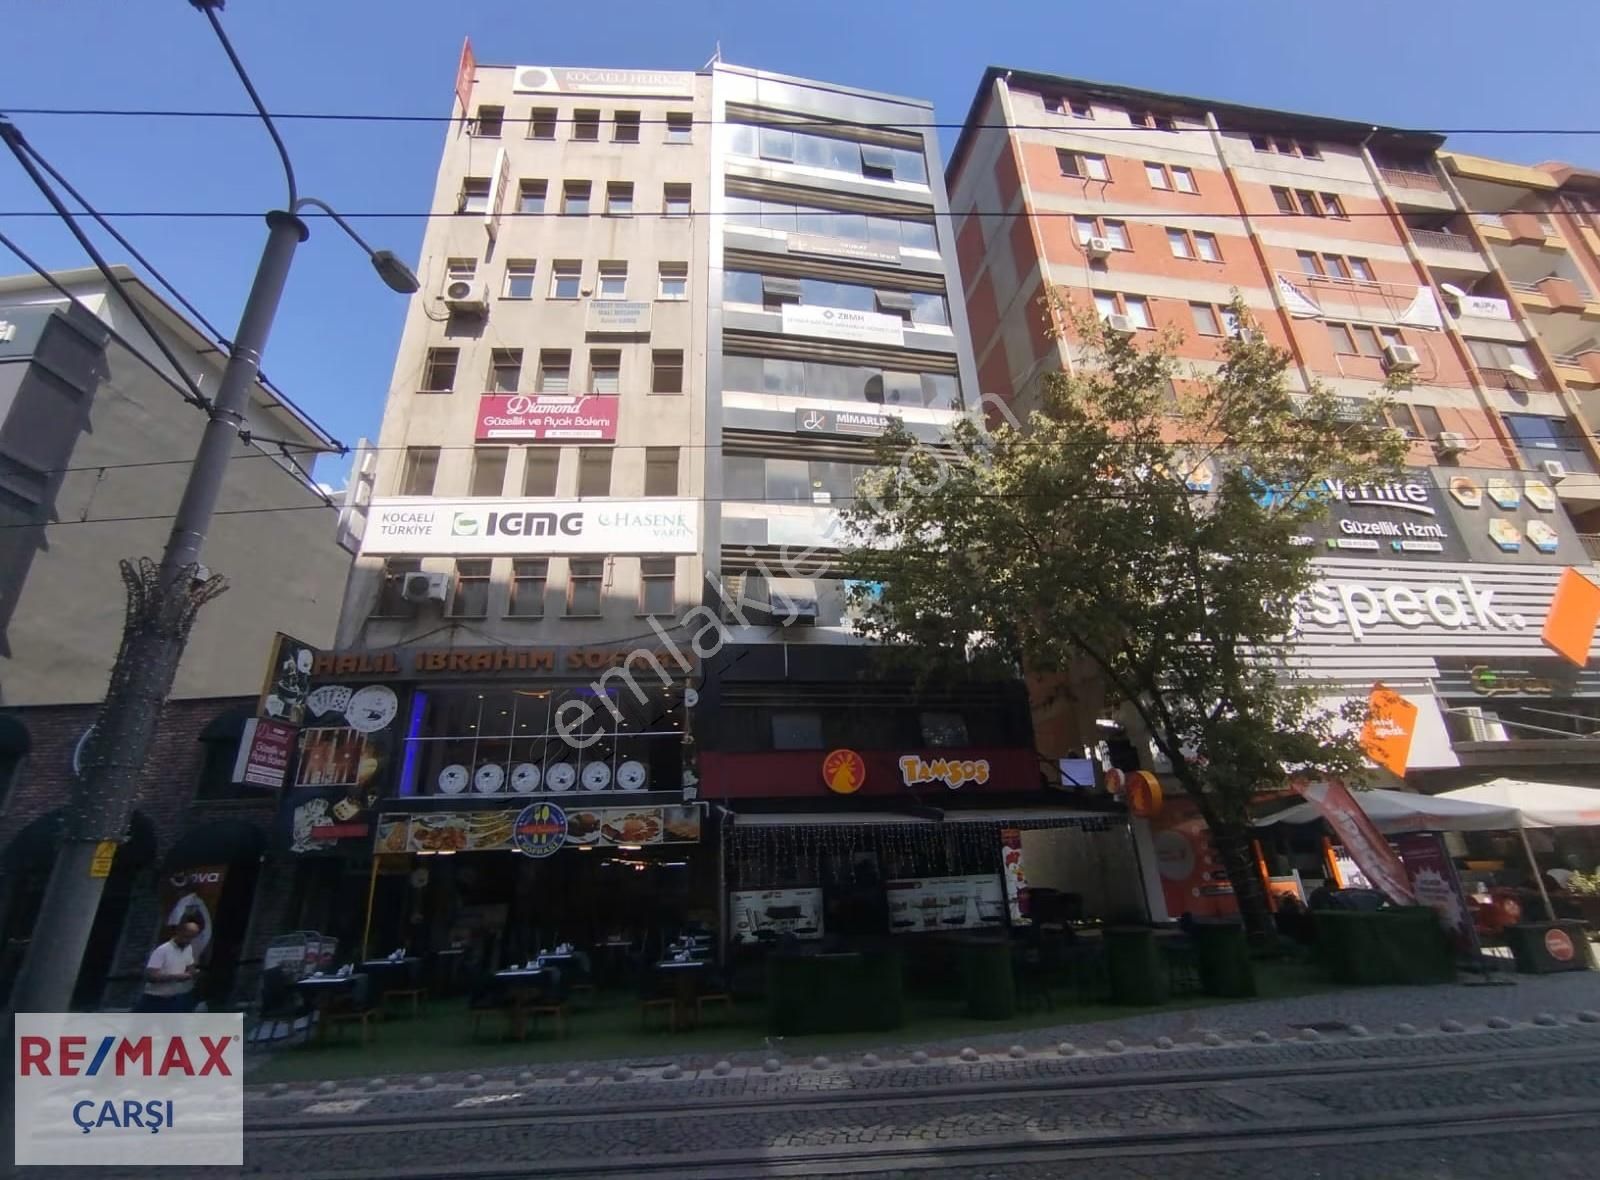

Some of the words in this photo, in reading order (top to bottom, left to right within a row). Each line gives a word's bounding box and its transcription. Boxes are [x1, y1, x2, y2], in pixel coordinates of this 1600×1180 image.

[506, 396, 591, 415] Diamond
[483, 416, 525, 426] Güzellik
[528, 418, 541, 426] ve
[544, 416, 571, 428] Ayak
[382, 511, 435, 522] KOCAELİ
[380, 524, 432, 535] TÜRKİYE
[1340, 519, 1401, 536] Güzellik
